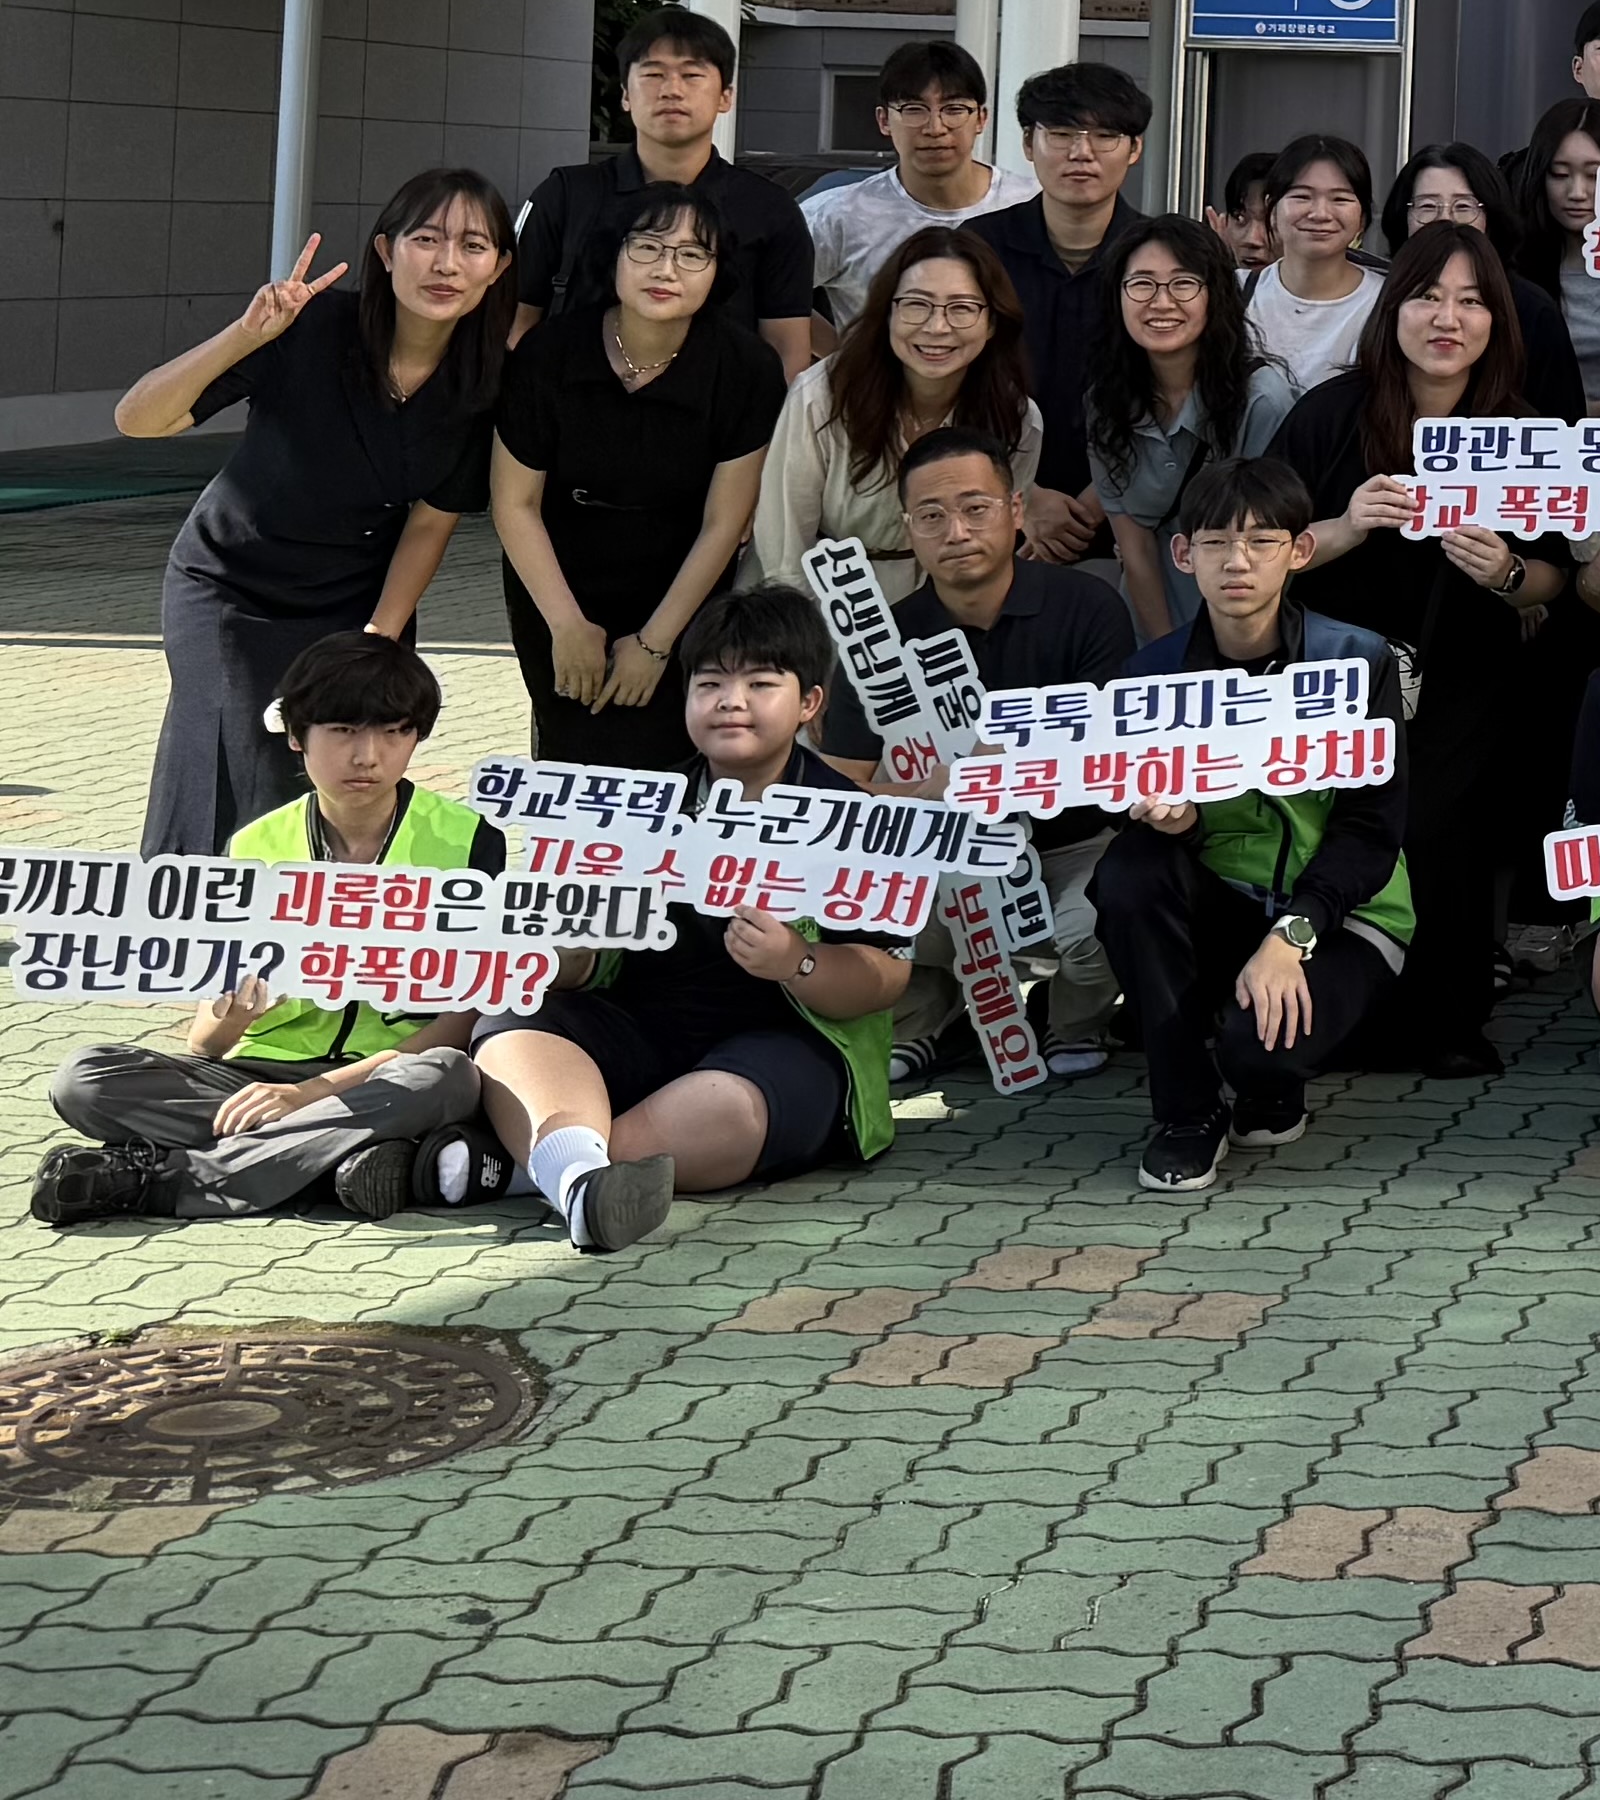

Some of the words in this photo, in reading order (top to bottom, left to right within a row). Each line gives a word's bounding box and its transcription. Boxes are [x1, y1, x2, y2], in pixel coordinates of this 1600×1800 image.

[1421, 425, 1561, 473] 방관도
[1497, 485, 1589, 533] 폭력
[913, 637, 982, 732] 싸울
[984, 692, 1092, 748] 툭툭
[1113, 677, 1272, 737] 던지는
[1292, 666, 1360, 720] 말!
[953, 758, 1062, 816] 콕콕
[1083, 744, 1243, 803] 박히는
[1262, 727, 1387, 788] 상처!
[477, 763, 684, 838] 학교폭력,
[707, 788, 1018, 868] 누군가에게는
[810, 545, 922, 727] 선생님께
[945, 882, 1041, 1088] 부탁해요!
[147, 864, 257, 923] 이런
[270, 869, 487, 934] 괴롭힘은
[501, 880, 669, 942] 많았다.
[704, 853, 807, 913] 없는
[822, 867, 930, 928] 상처
[21, 932, 286, 995] 장난인가?
[300, 941, 550, 1007] 학폭인가?
